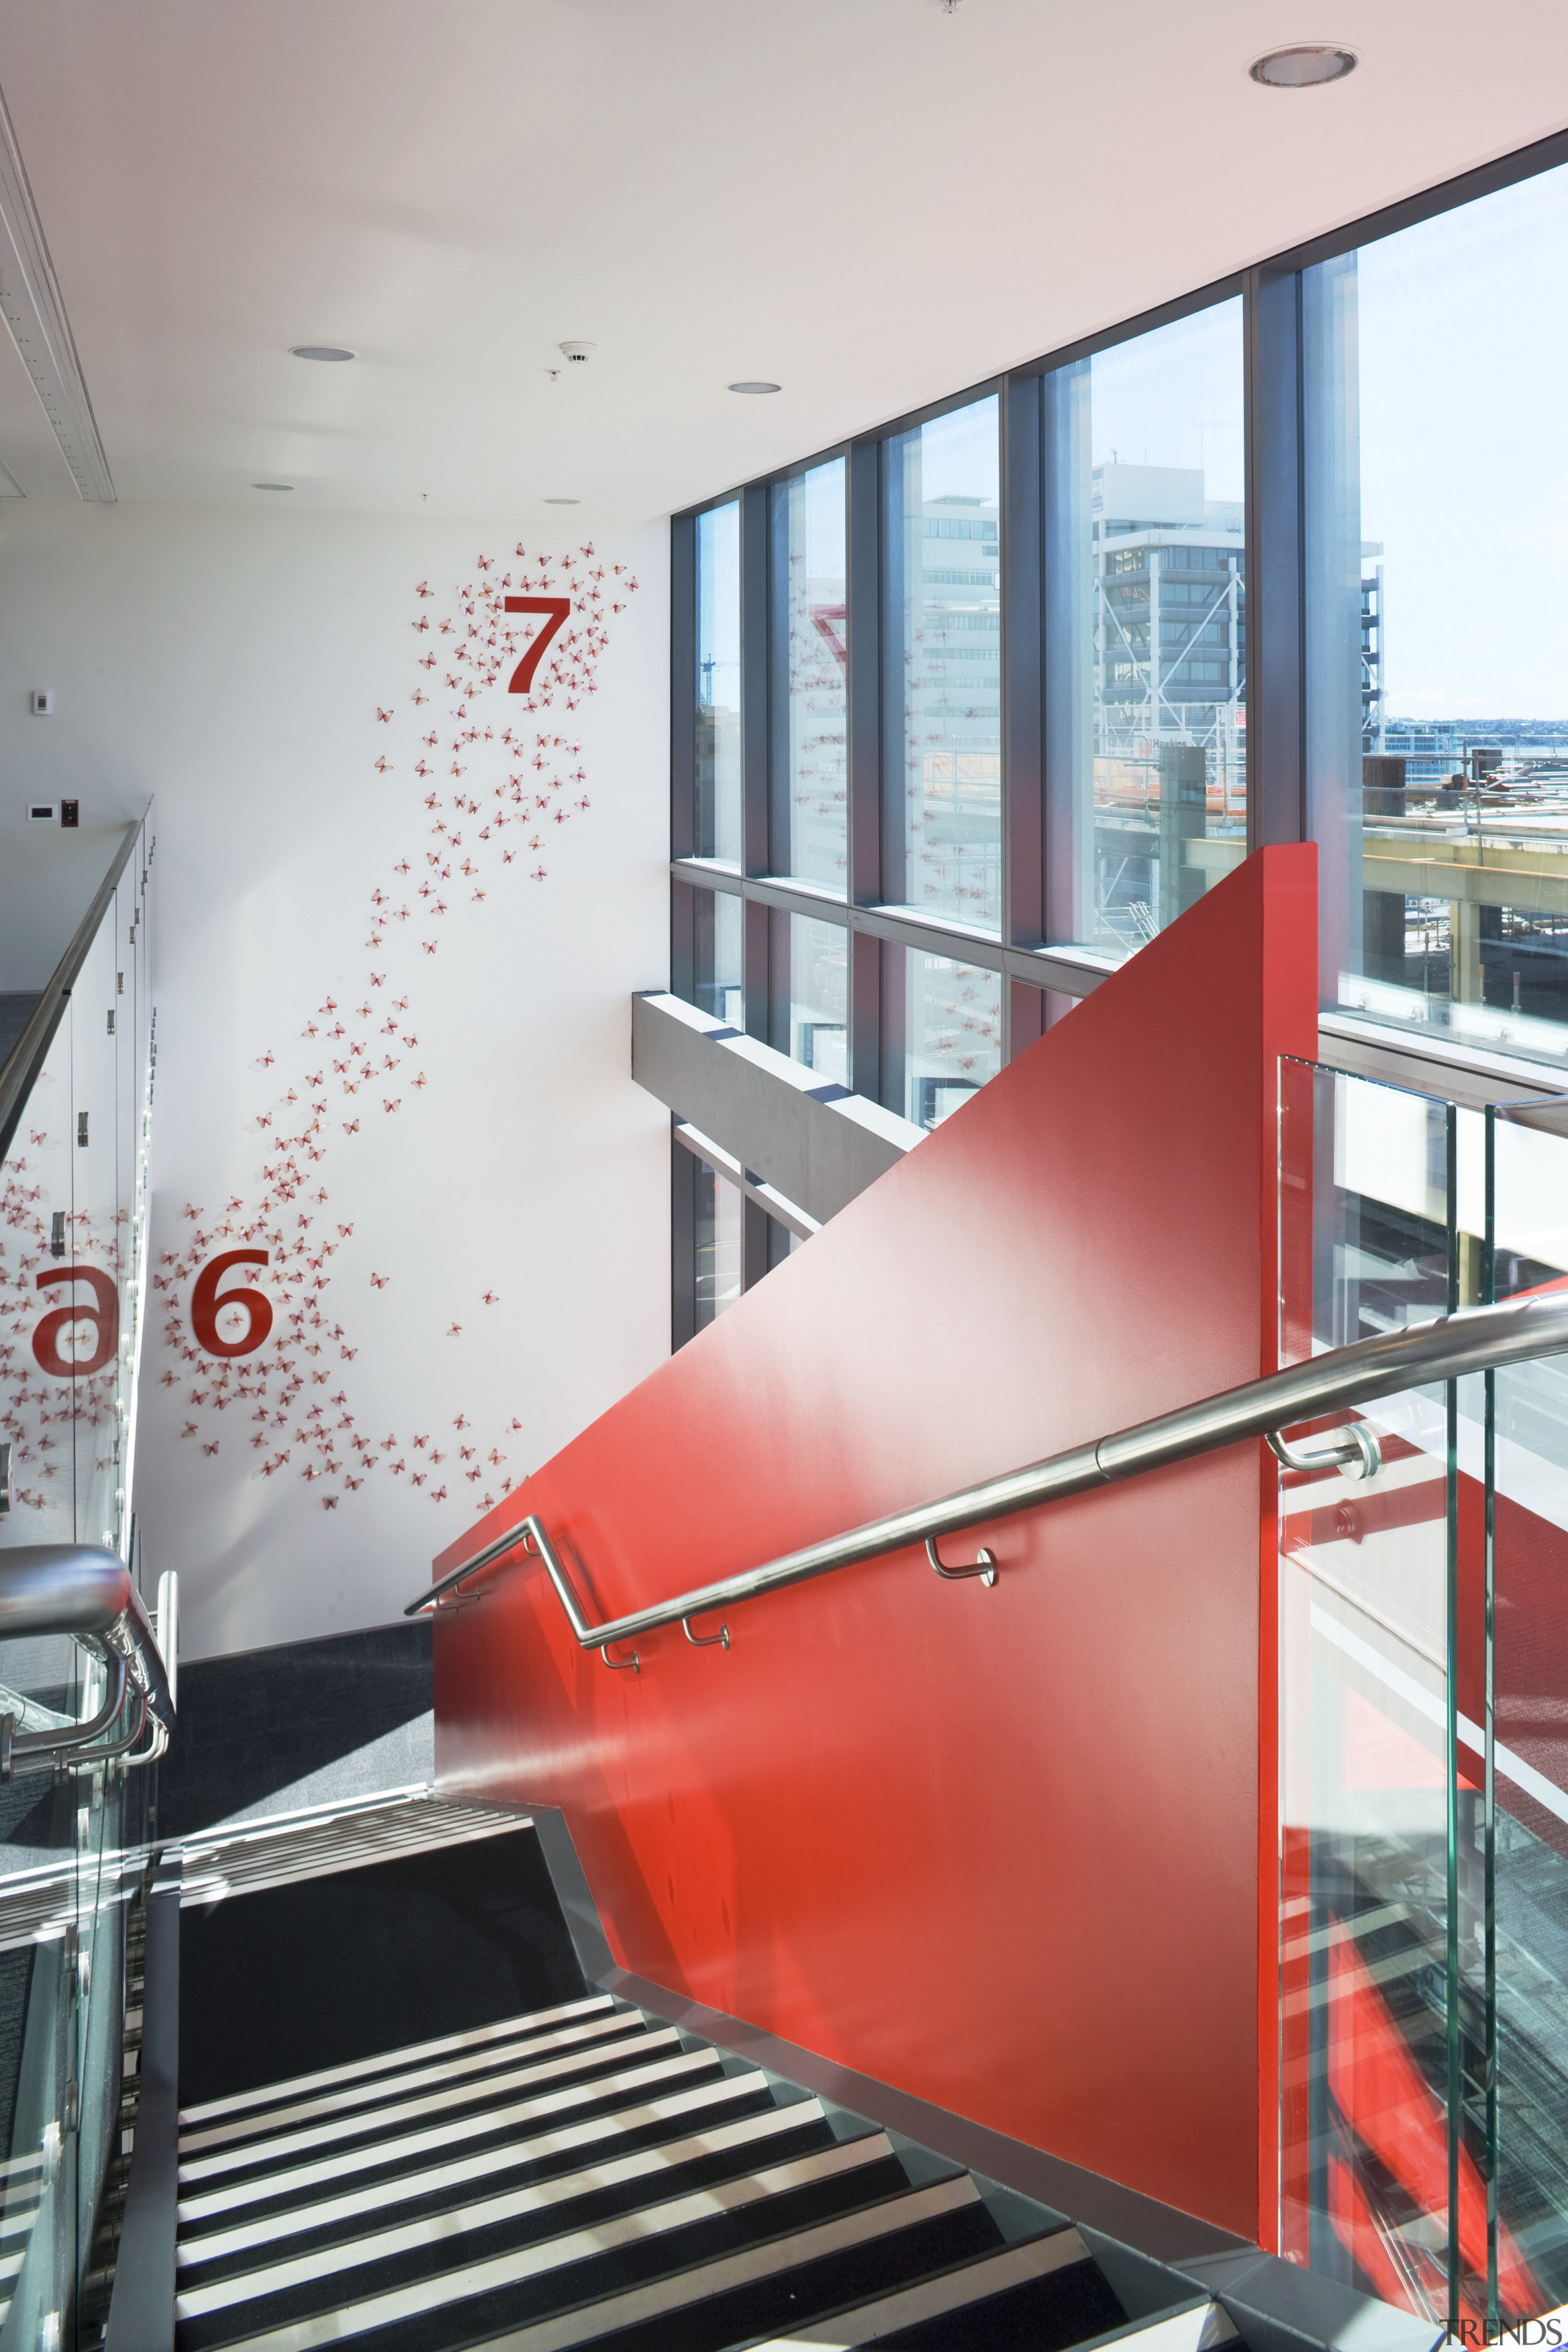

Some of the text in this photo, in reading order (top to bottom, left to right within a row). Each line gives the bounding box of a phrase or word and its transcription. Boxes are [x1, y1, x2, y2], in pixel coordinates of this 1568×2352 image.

[504, 596, 571, 693] 7
[1153, 739, 1187, 748] Hawkins
[192, 1248, 273, 1357] 6
